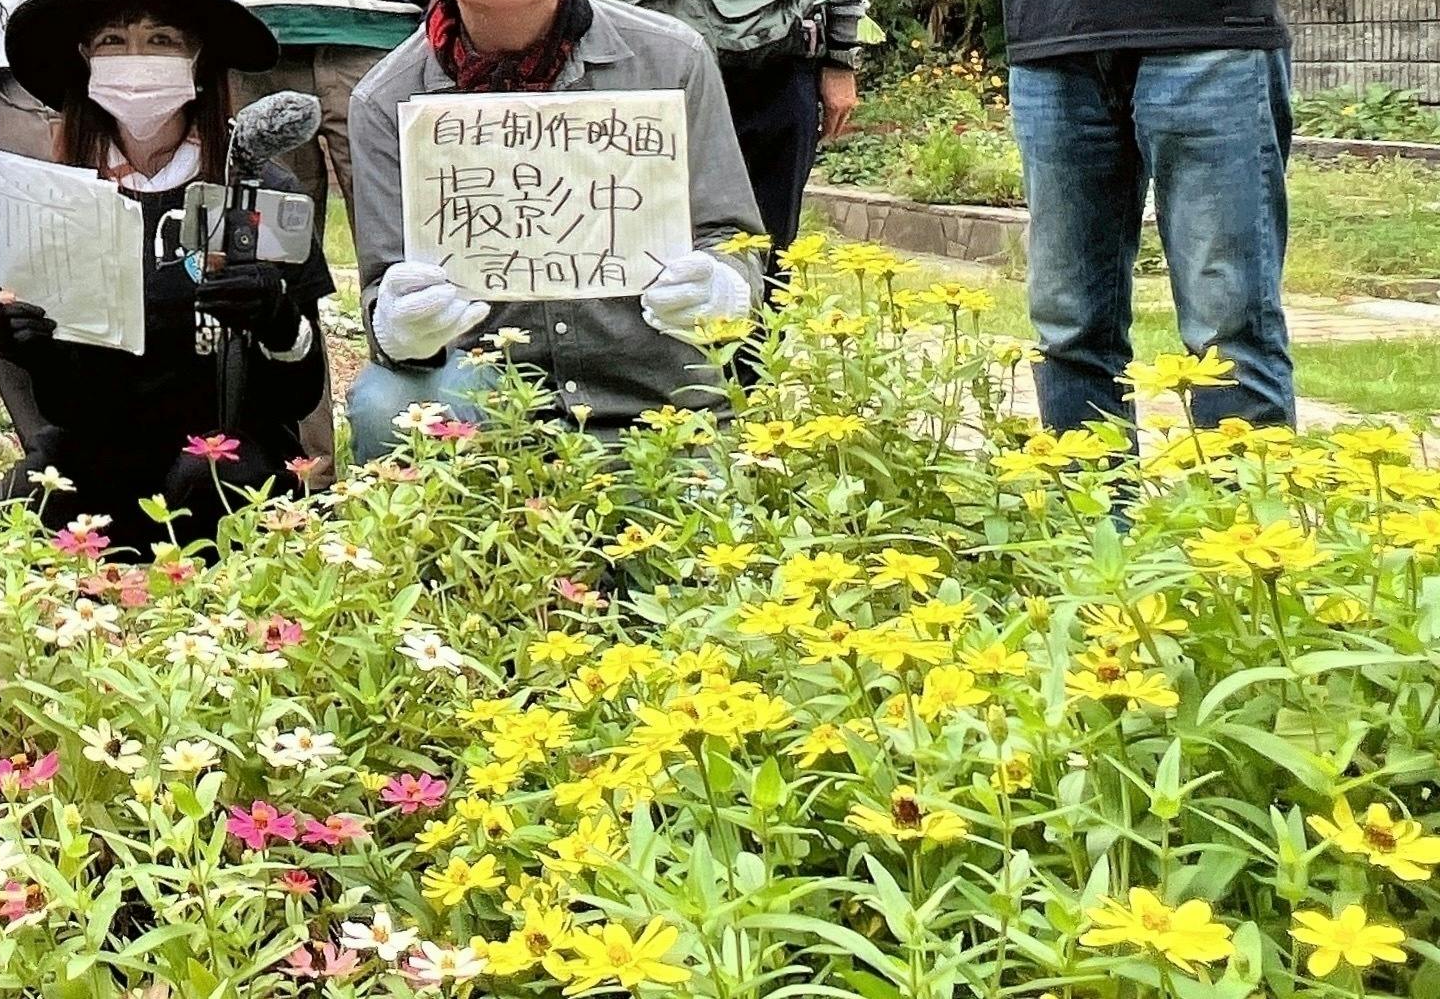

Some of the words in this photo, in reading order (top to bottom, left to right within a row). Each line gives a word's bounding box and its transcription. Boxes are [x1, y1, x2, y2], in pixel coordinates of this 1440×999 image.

[434, 108, 676, 161] 自主制作映画
[424, 162, 644, 256] 撮影中
